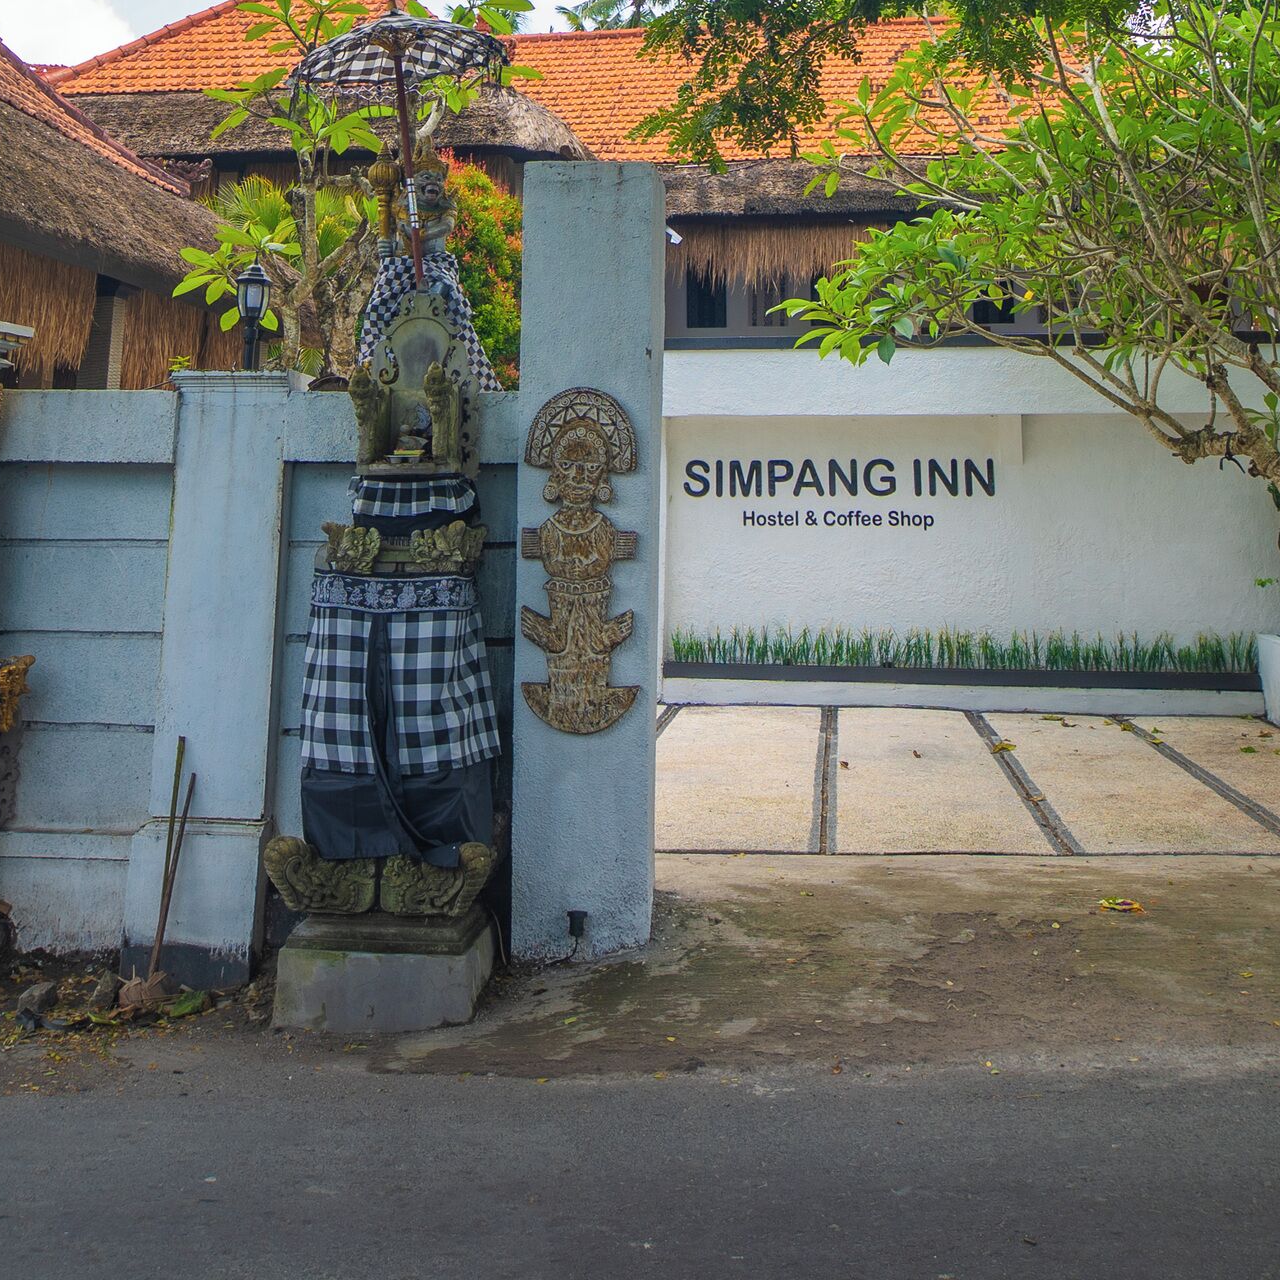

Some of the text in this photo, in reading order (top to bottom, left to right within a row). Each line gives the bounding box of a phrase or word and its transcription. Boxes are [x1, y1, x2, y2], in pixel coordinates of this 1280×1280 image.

[683, 458, 996, 498] SIMPANG INN
[742, 510, 935, 531] Hostel & Coffee Shop
